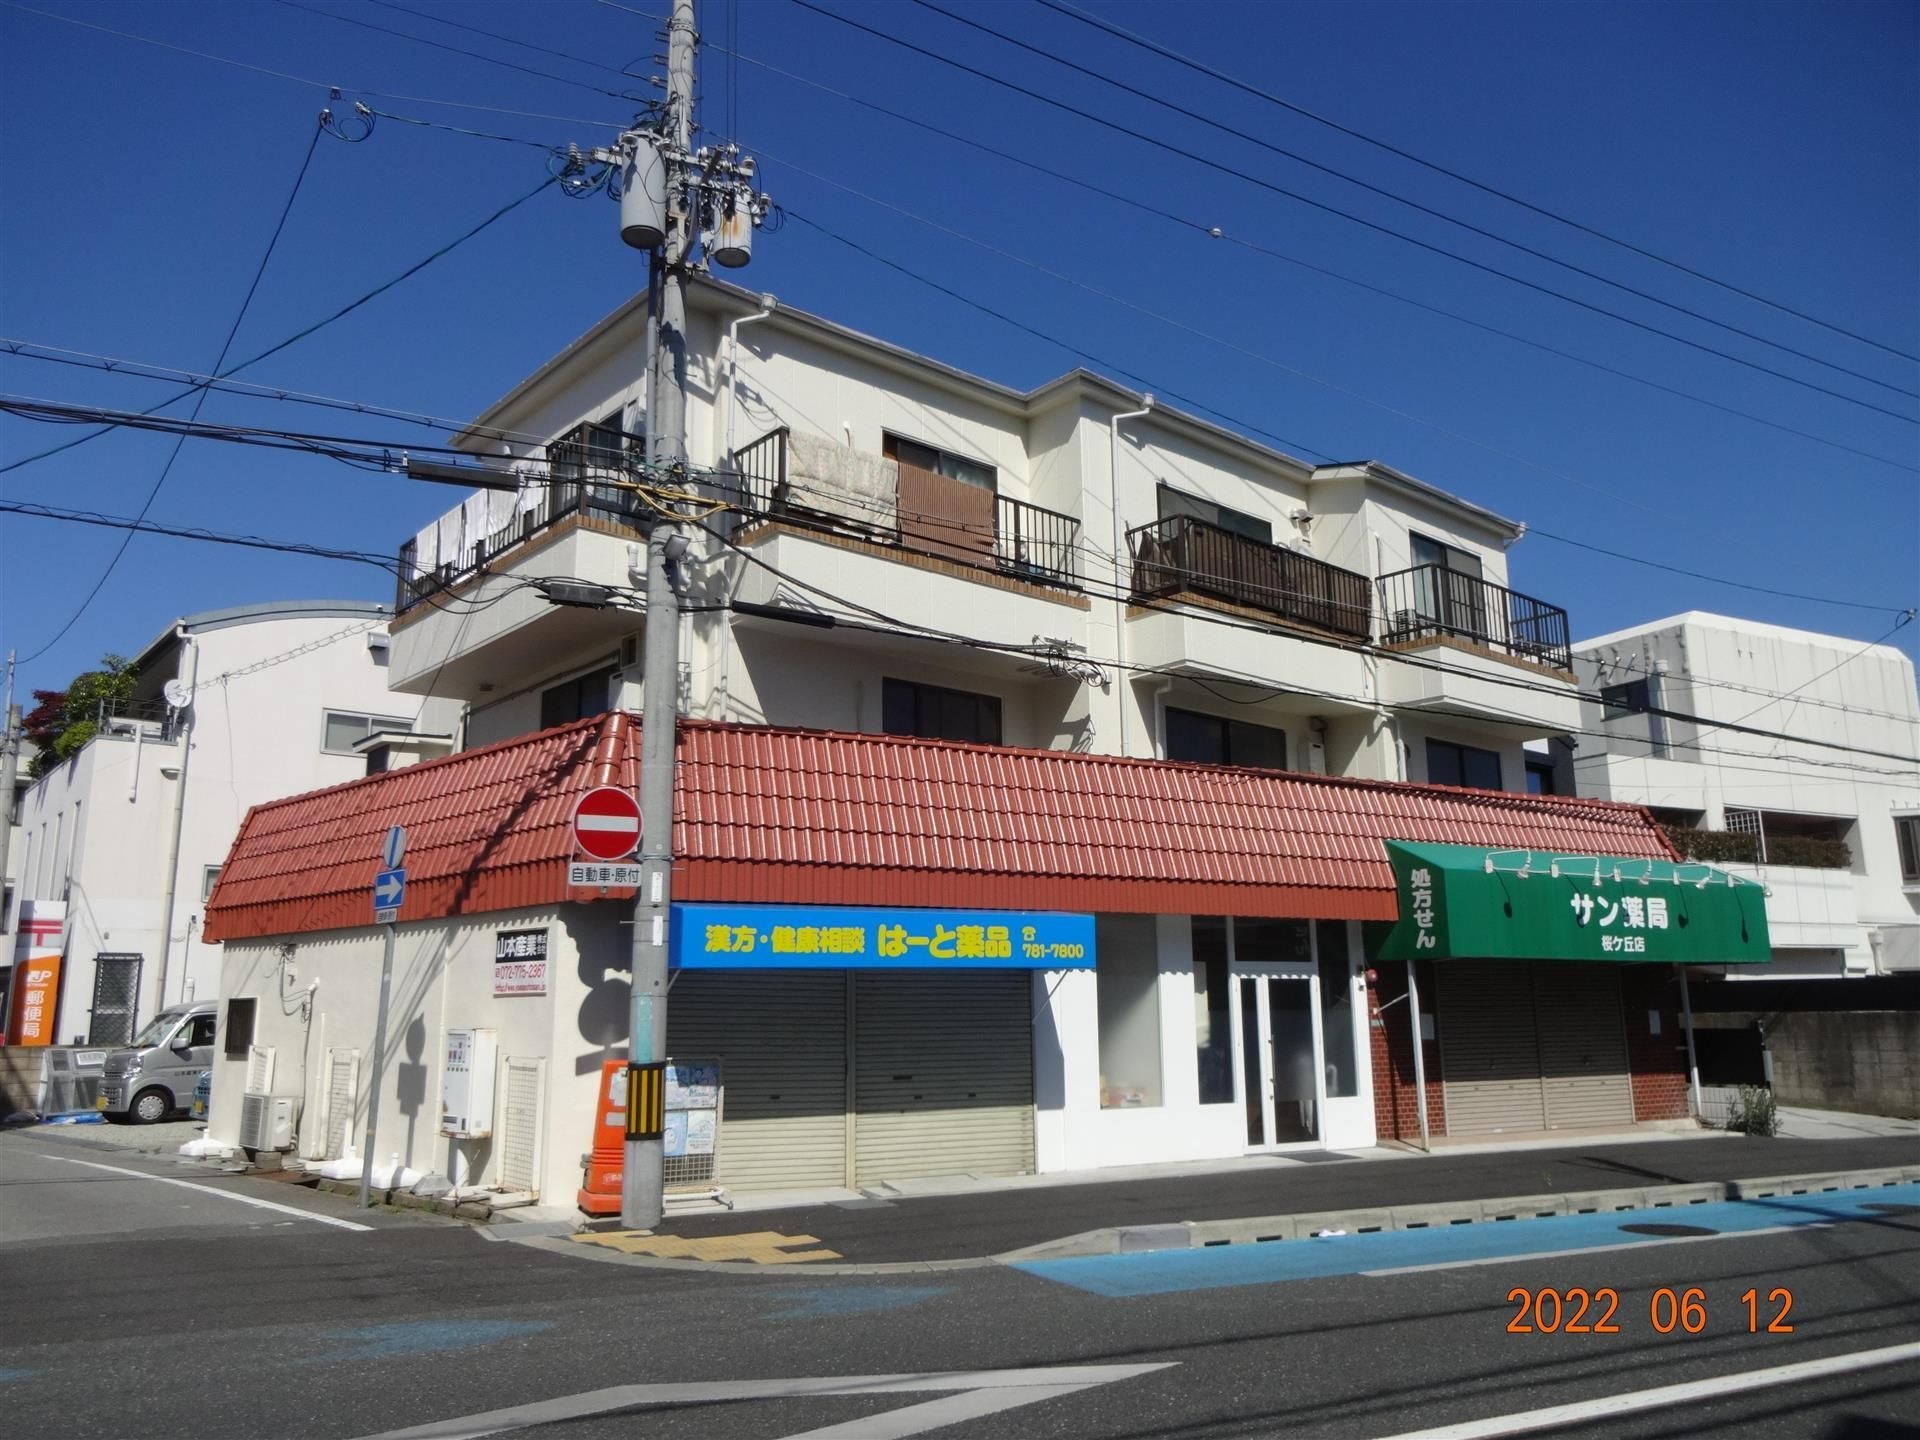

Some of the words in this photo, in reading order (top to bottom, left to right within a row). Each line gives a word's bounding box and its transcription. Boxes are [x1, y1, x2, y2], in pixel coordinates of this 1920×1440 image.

[572, 866, 640, 883] 自動車・原付
[1410, 868, 1436, 950] 処方せん
[1570, 892, 1669, 930] サン薬局
[496, 935, 537, 957] 山本産業
[705, 925, 865, 953] 漢方・健康相談
[878, 923, 1011, 959] はーと薬品
[1022, 943, 1084, 959] 781-7800
[24, 990, 45, 1037] 郵便局
